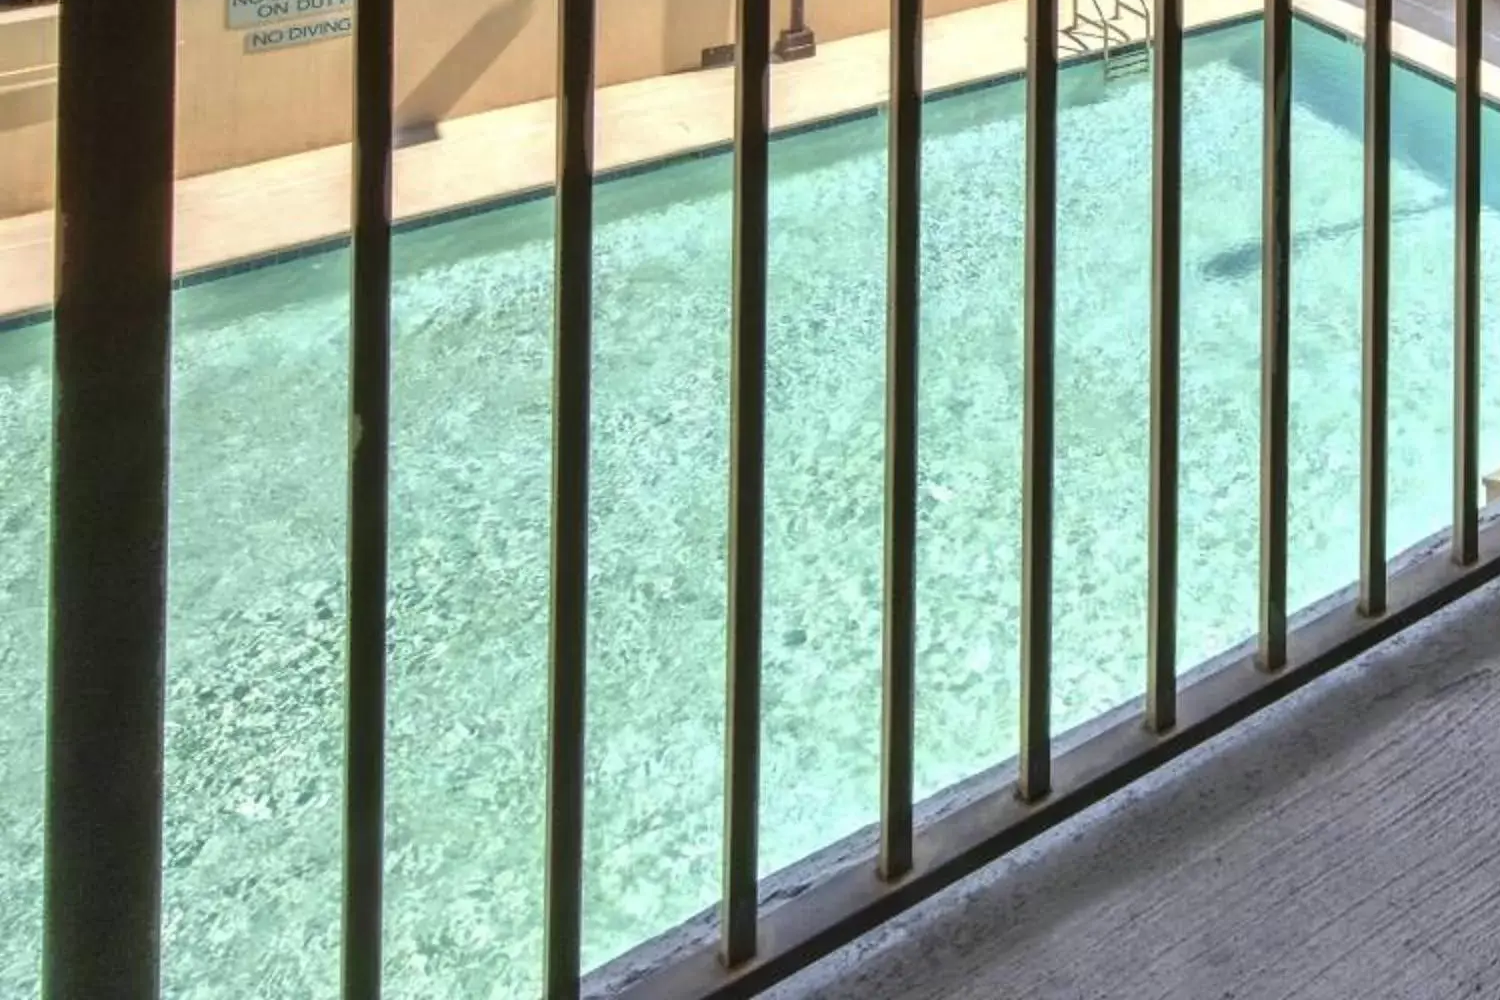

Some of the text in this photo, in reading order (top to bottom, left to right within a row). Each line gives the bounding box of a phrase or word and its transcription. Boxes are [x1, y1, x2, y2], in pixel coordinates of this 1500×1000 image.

[257, 3, 289, 18] ON
[253, 18, 351, 47] NO DIVING
